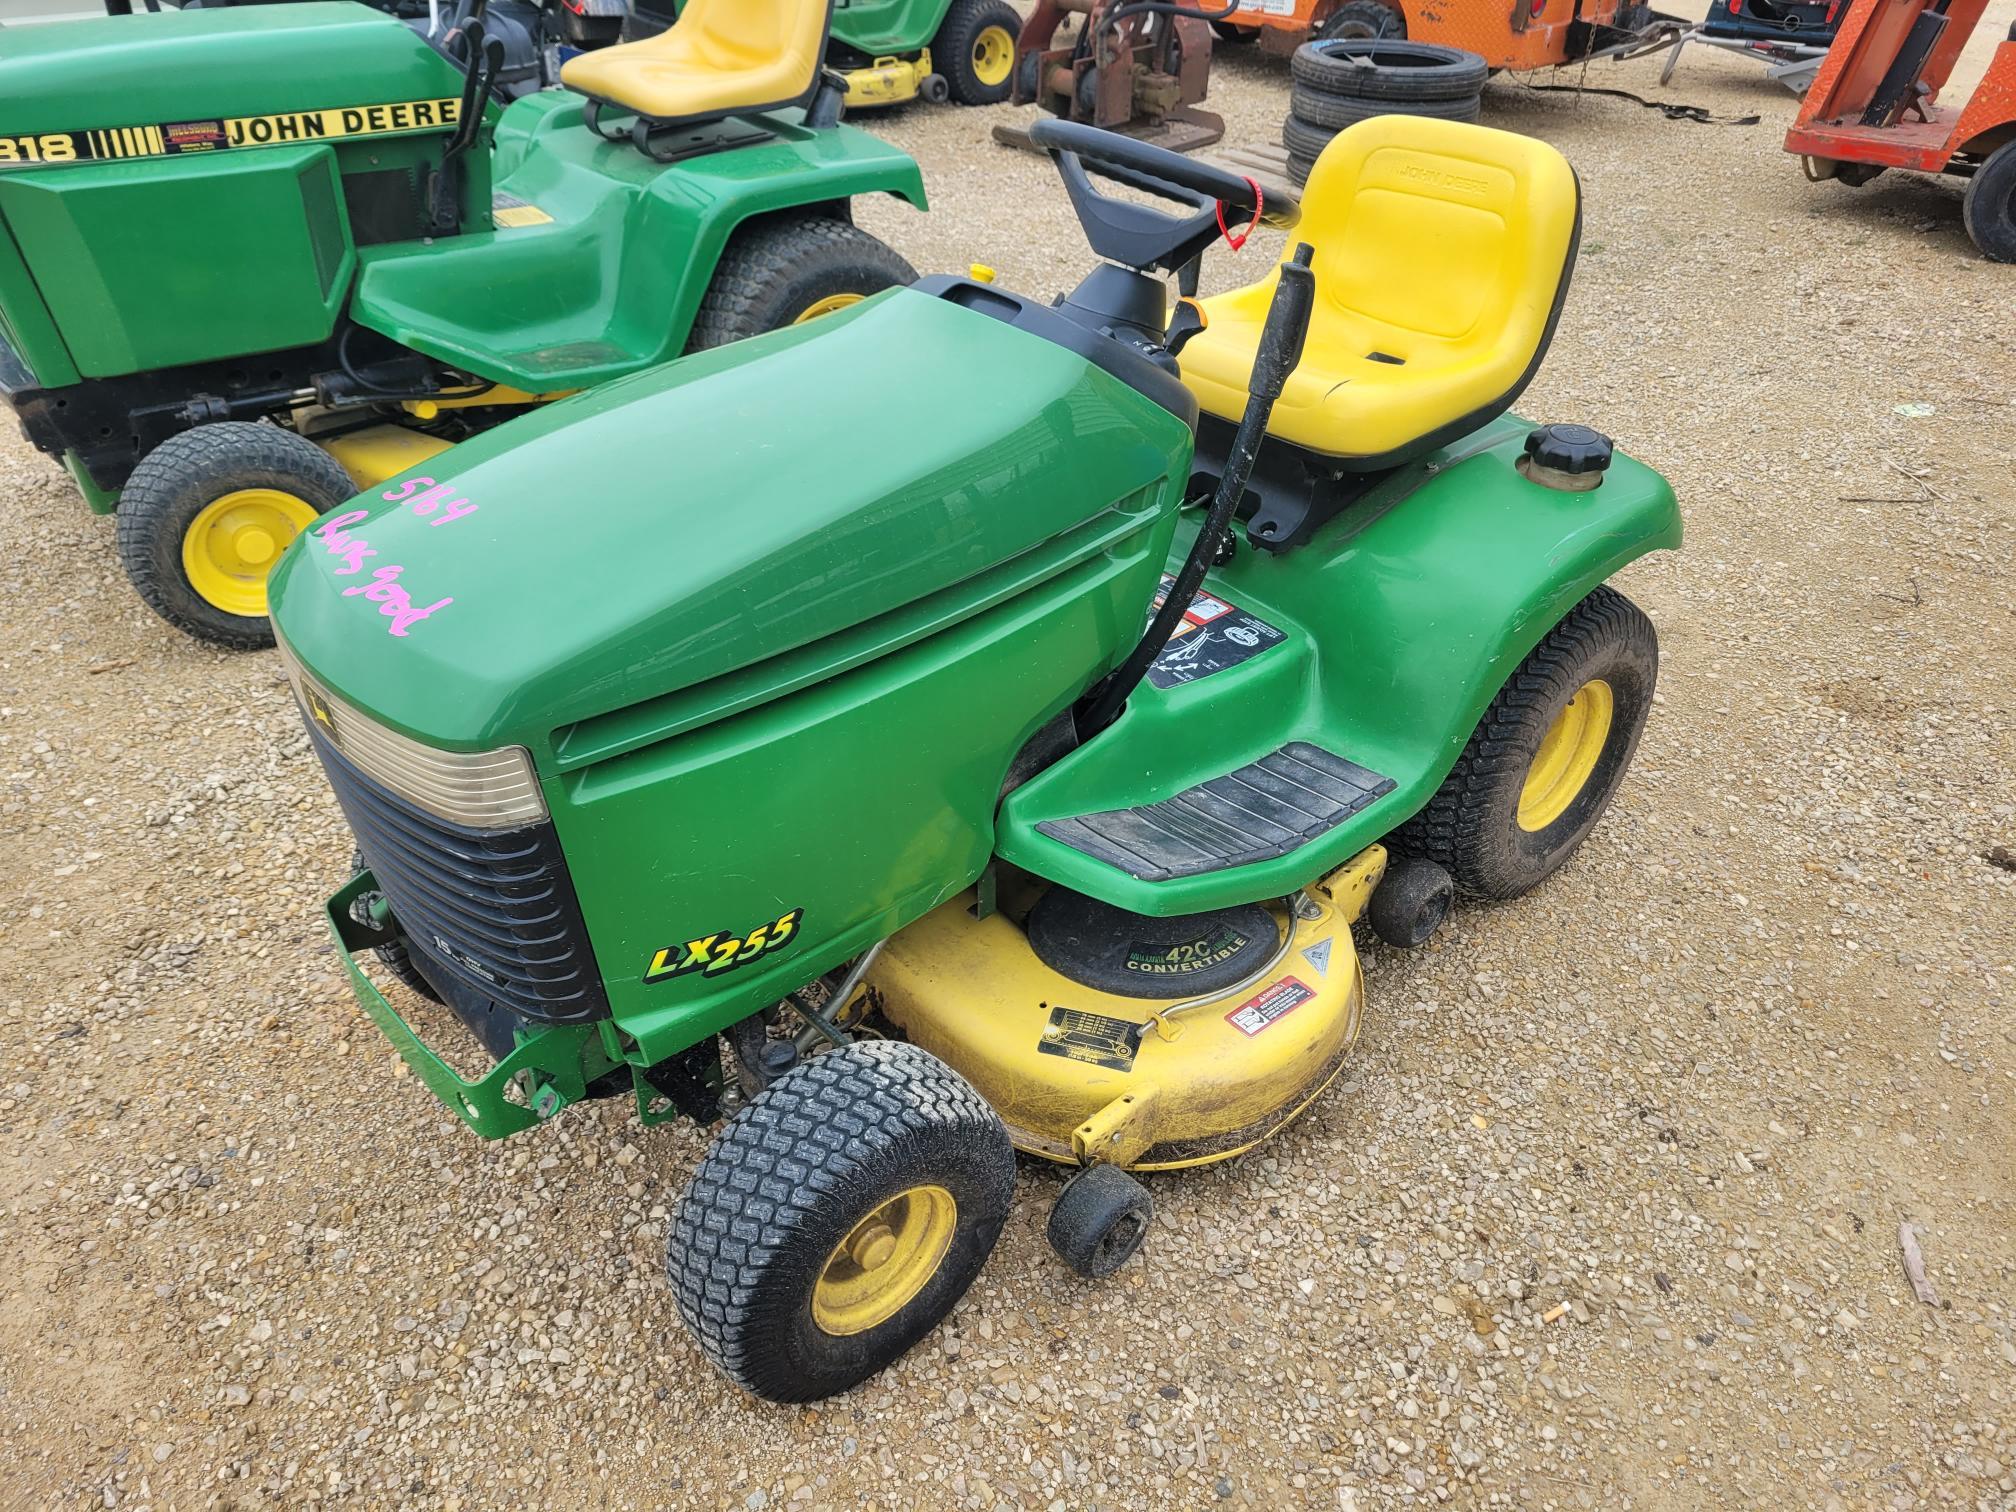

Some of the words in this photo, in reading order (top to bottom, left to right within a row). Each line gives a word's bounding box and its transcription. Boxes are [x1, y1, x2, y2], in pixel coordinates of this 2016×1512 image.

[232, 113, 325, 145] JOHN
[342, 101, 457, 133] DEERE
[1400, 166, 1441, 185] JOHN
[1443, 174, 1488, 196] DEERE
[382, 477, 479, 527] 5164
[643, 910, 803, 981] LX255
[1127, 937, 1246, 973] CONVERTIBLE
[1166, 941, 1210, 963] 42C
